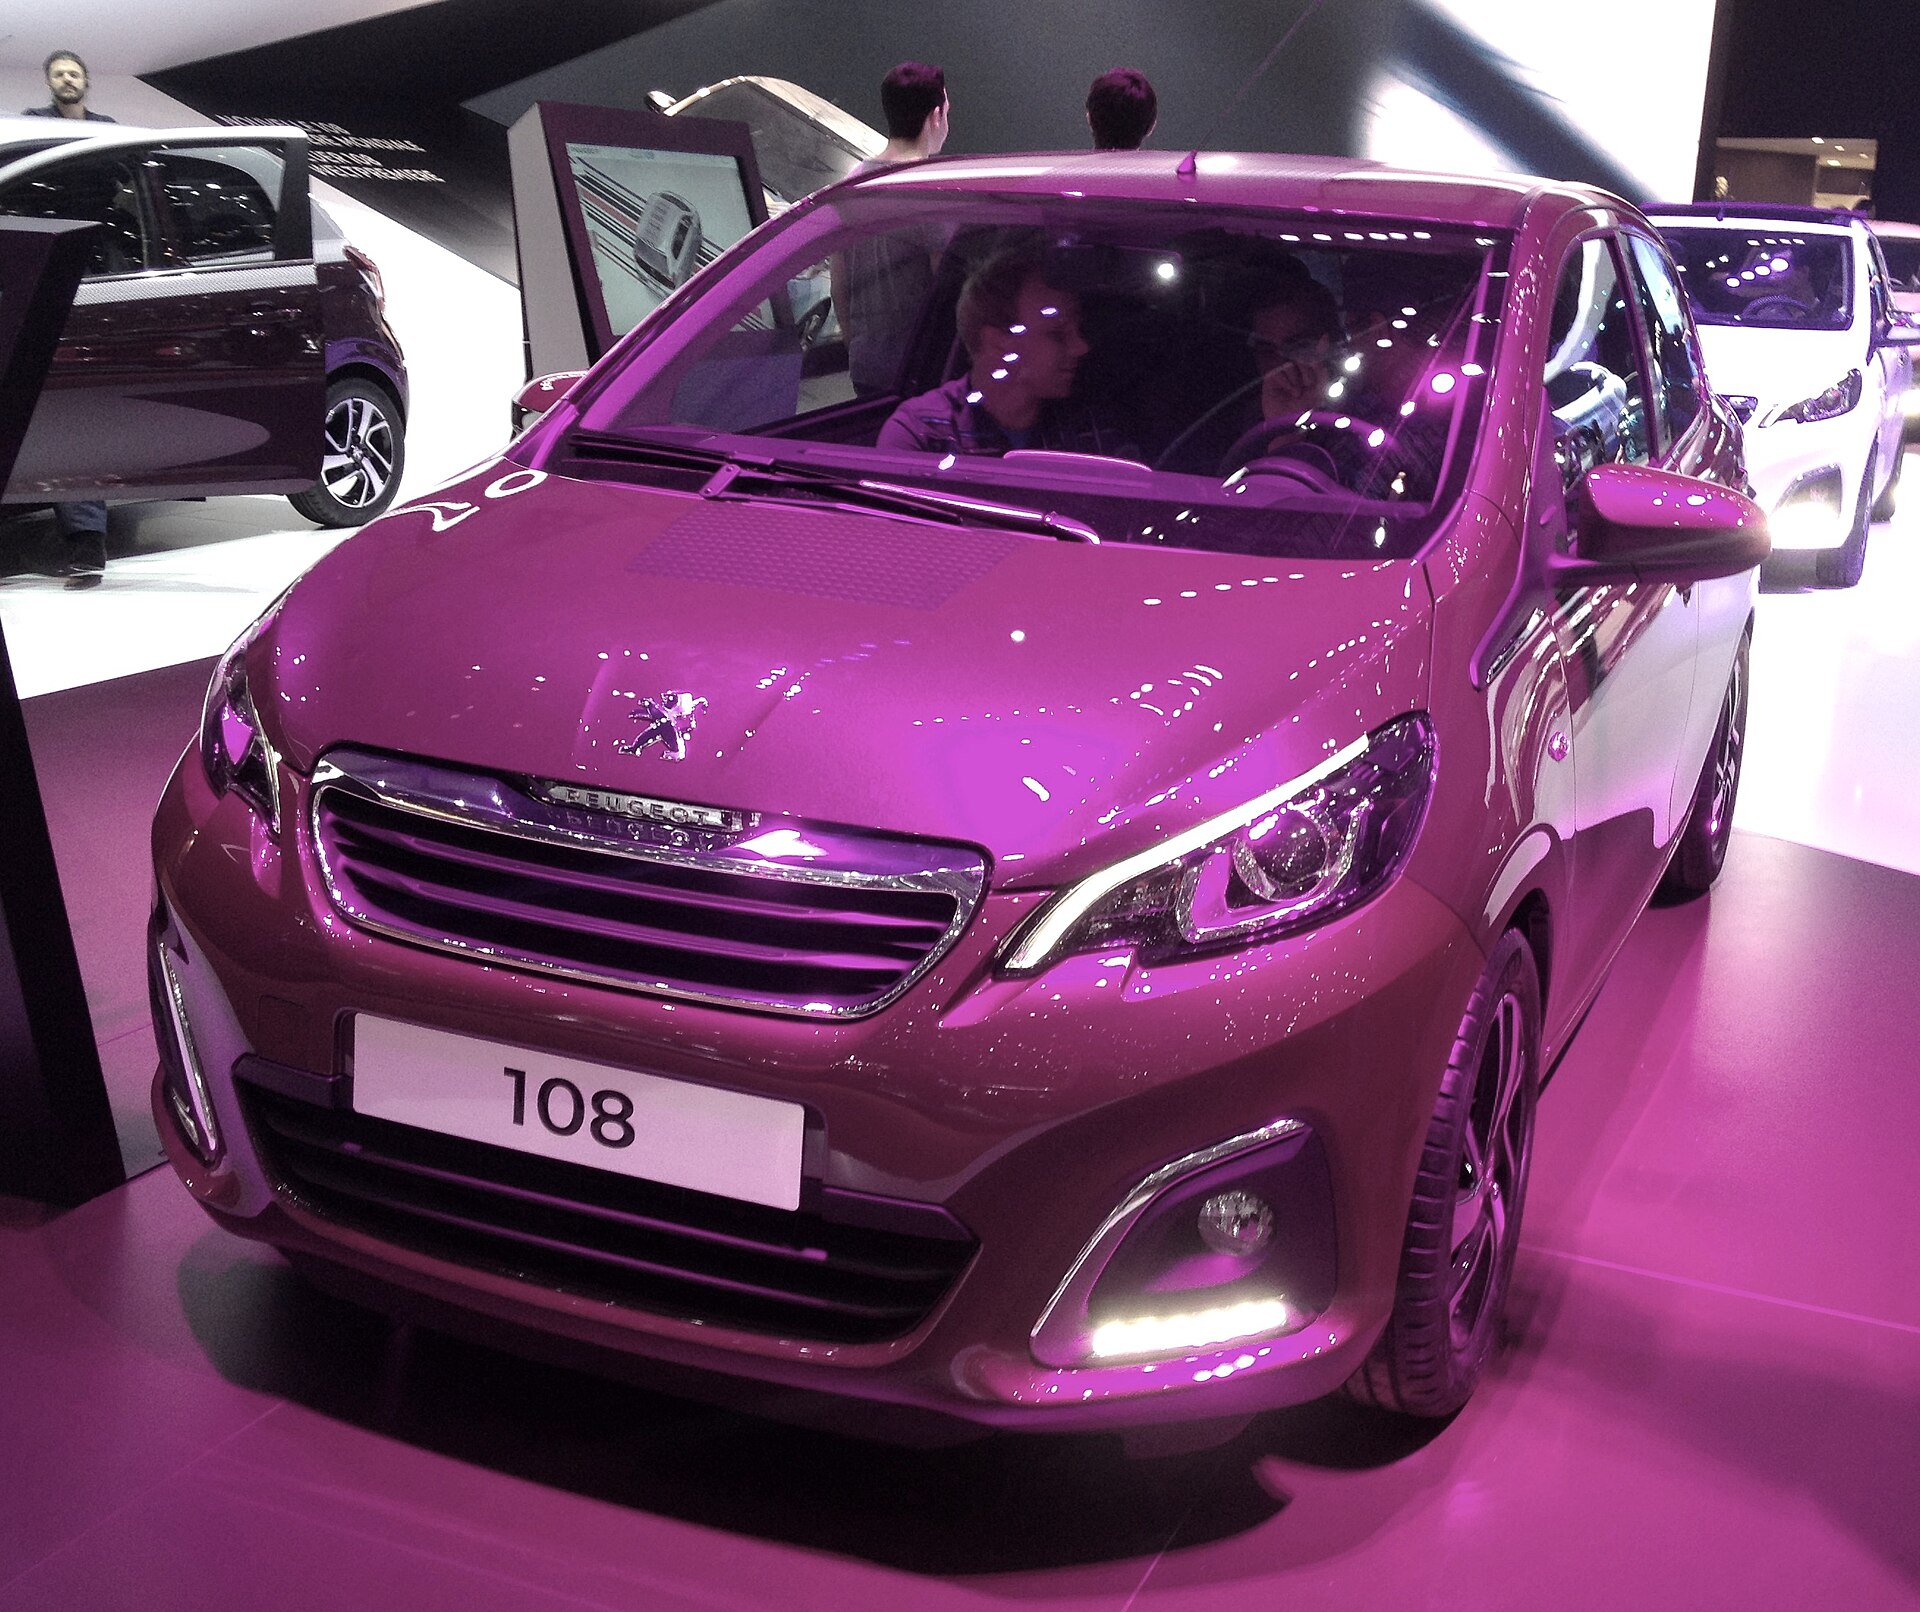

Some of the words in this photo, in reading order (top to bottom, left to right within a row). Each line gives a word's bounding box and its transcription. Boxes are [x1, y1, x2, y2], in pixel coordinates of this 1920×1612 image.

[309, 121, 351, 135] 108
[332, 136, 427, 152] MONDIALE
[340, 152, 383, 167] 108
[566, 788, 710, 826] PEUGEOT
[503, 1066, 635, 1149] 108
